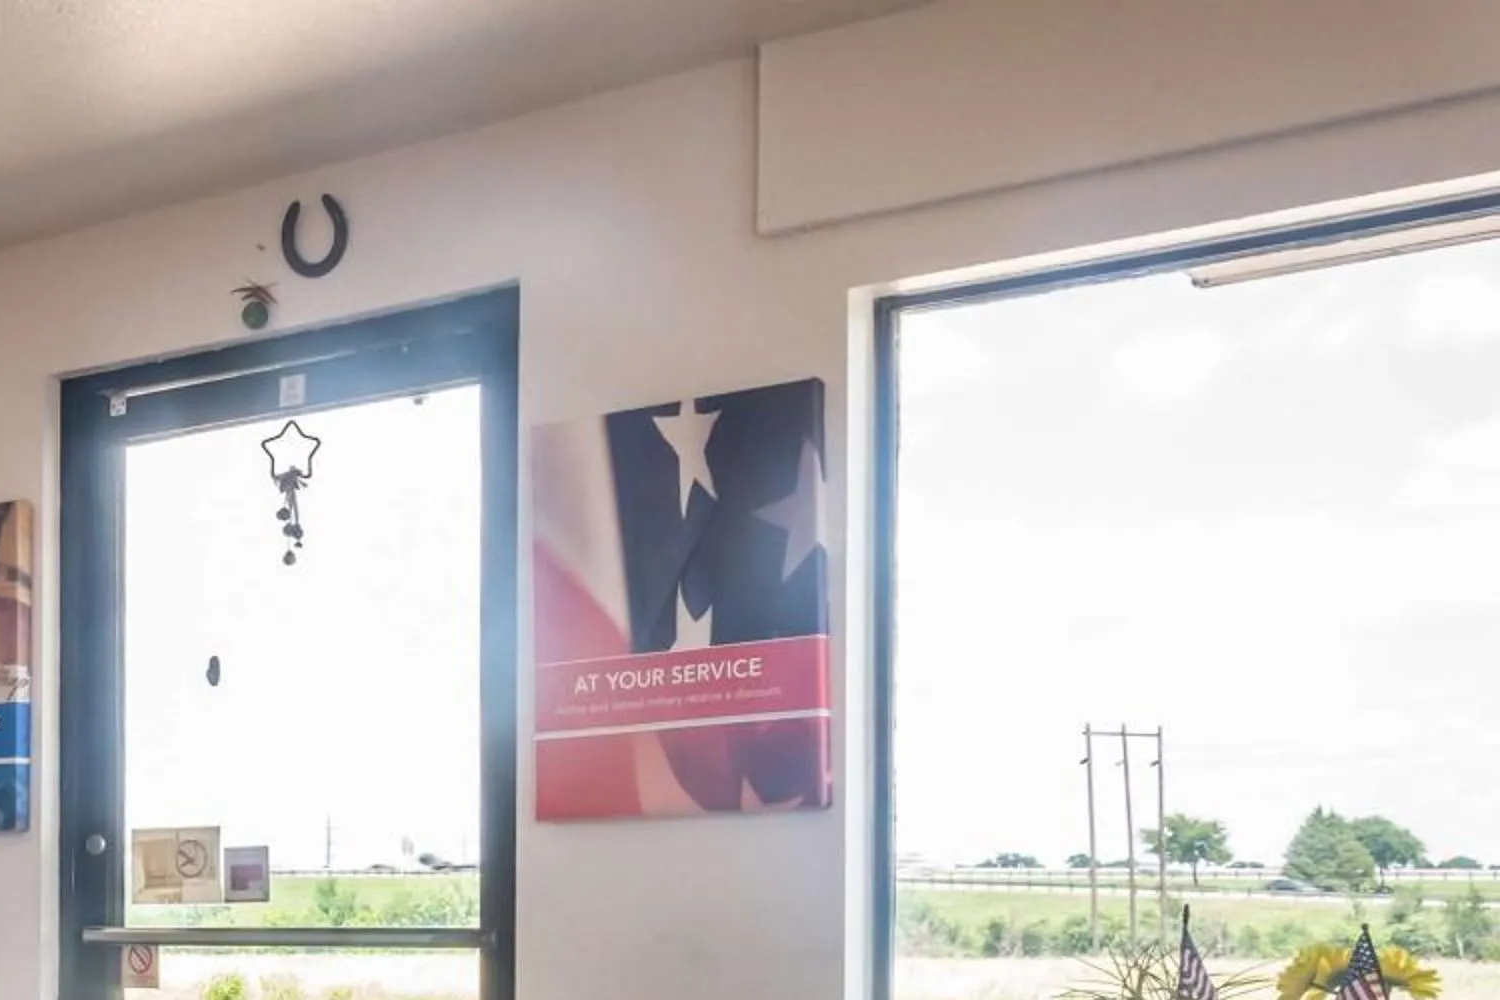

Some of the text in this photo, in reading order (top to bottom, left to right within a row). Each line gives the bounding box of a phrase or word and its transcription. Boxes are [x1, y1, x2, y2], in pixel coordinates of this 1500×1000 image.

[574, 657, 763, 694] AT YOUR SERVICE
